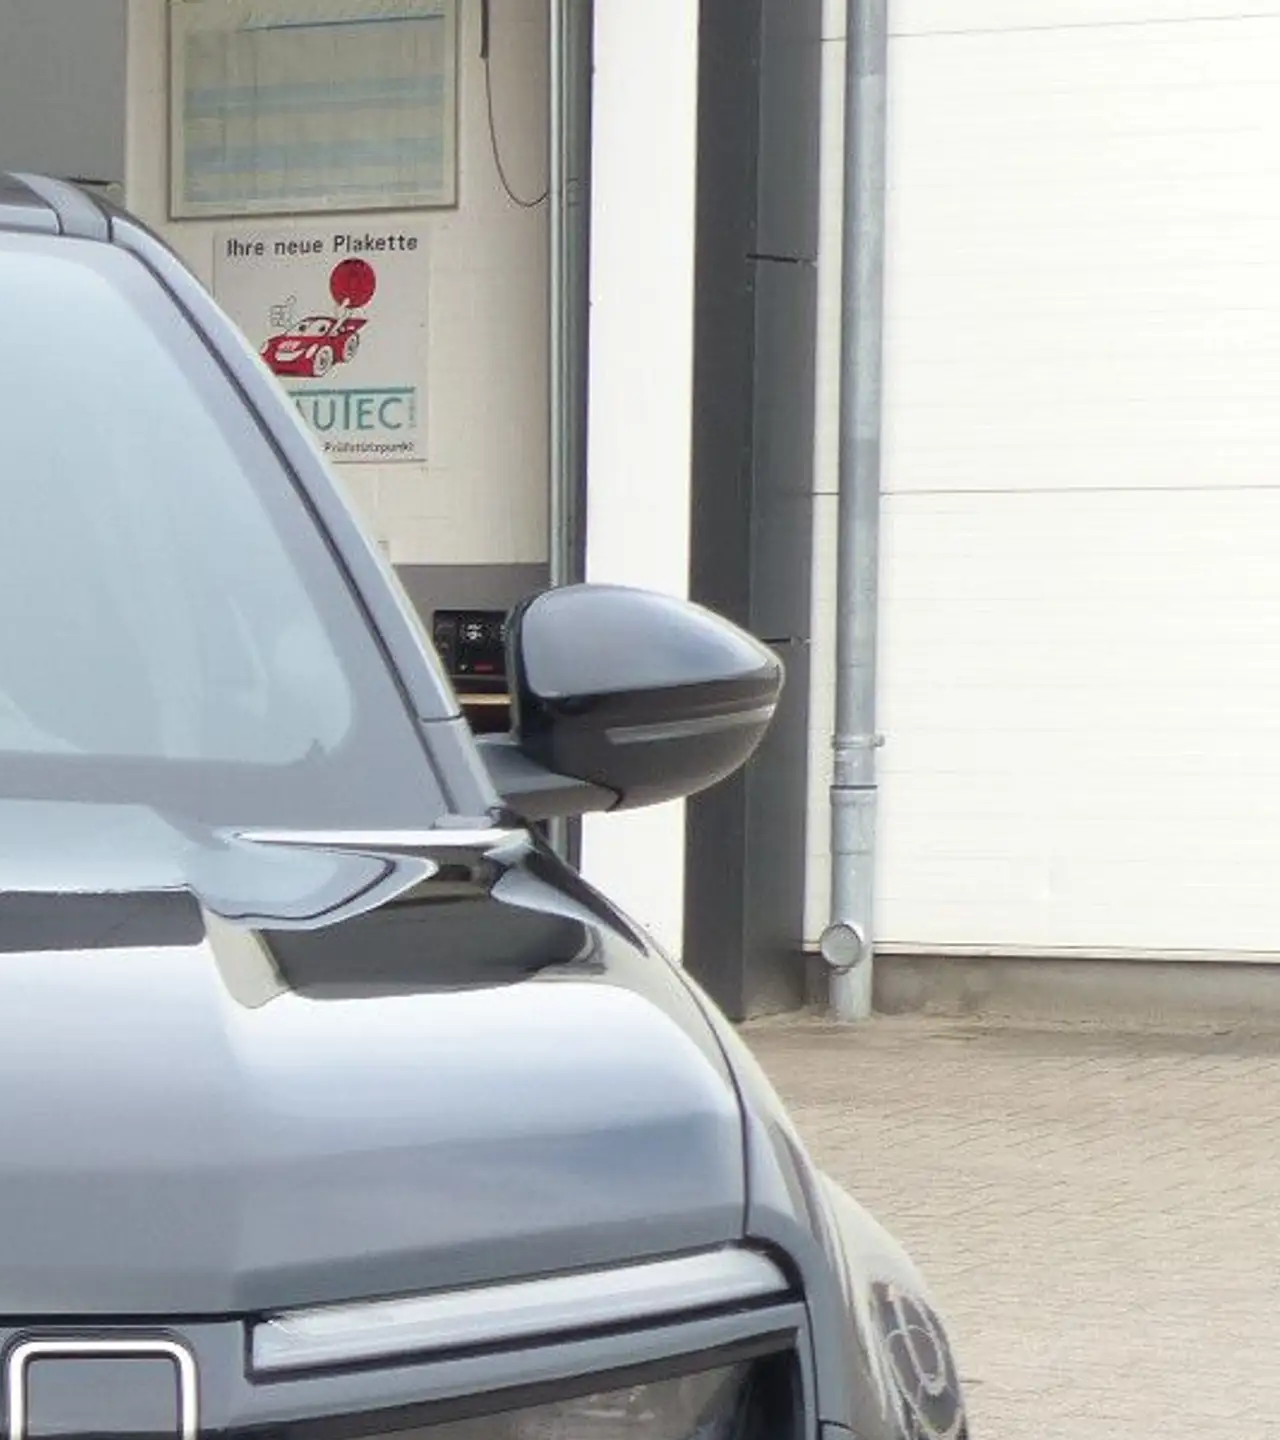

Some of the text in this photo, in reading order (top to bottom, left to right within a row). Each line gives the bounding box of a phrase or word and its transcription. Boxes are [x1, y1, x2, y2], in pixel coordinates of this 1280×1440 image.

[226, 234, 419, 257] Ihre neue Plakette
